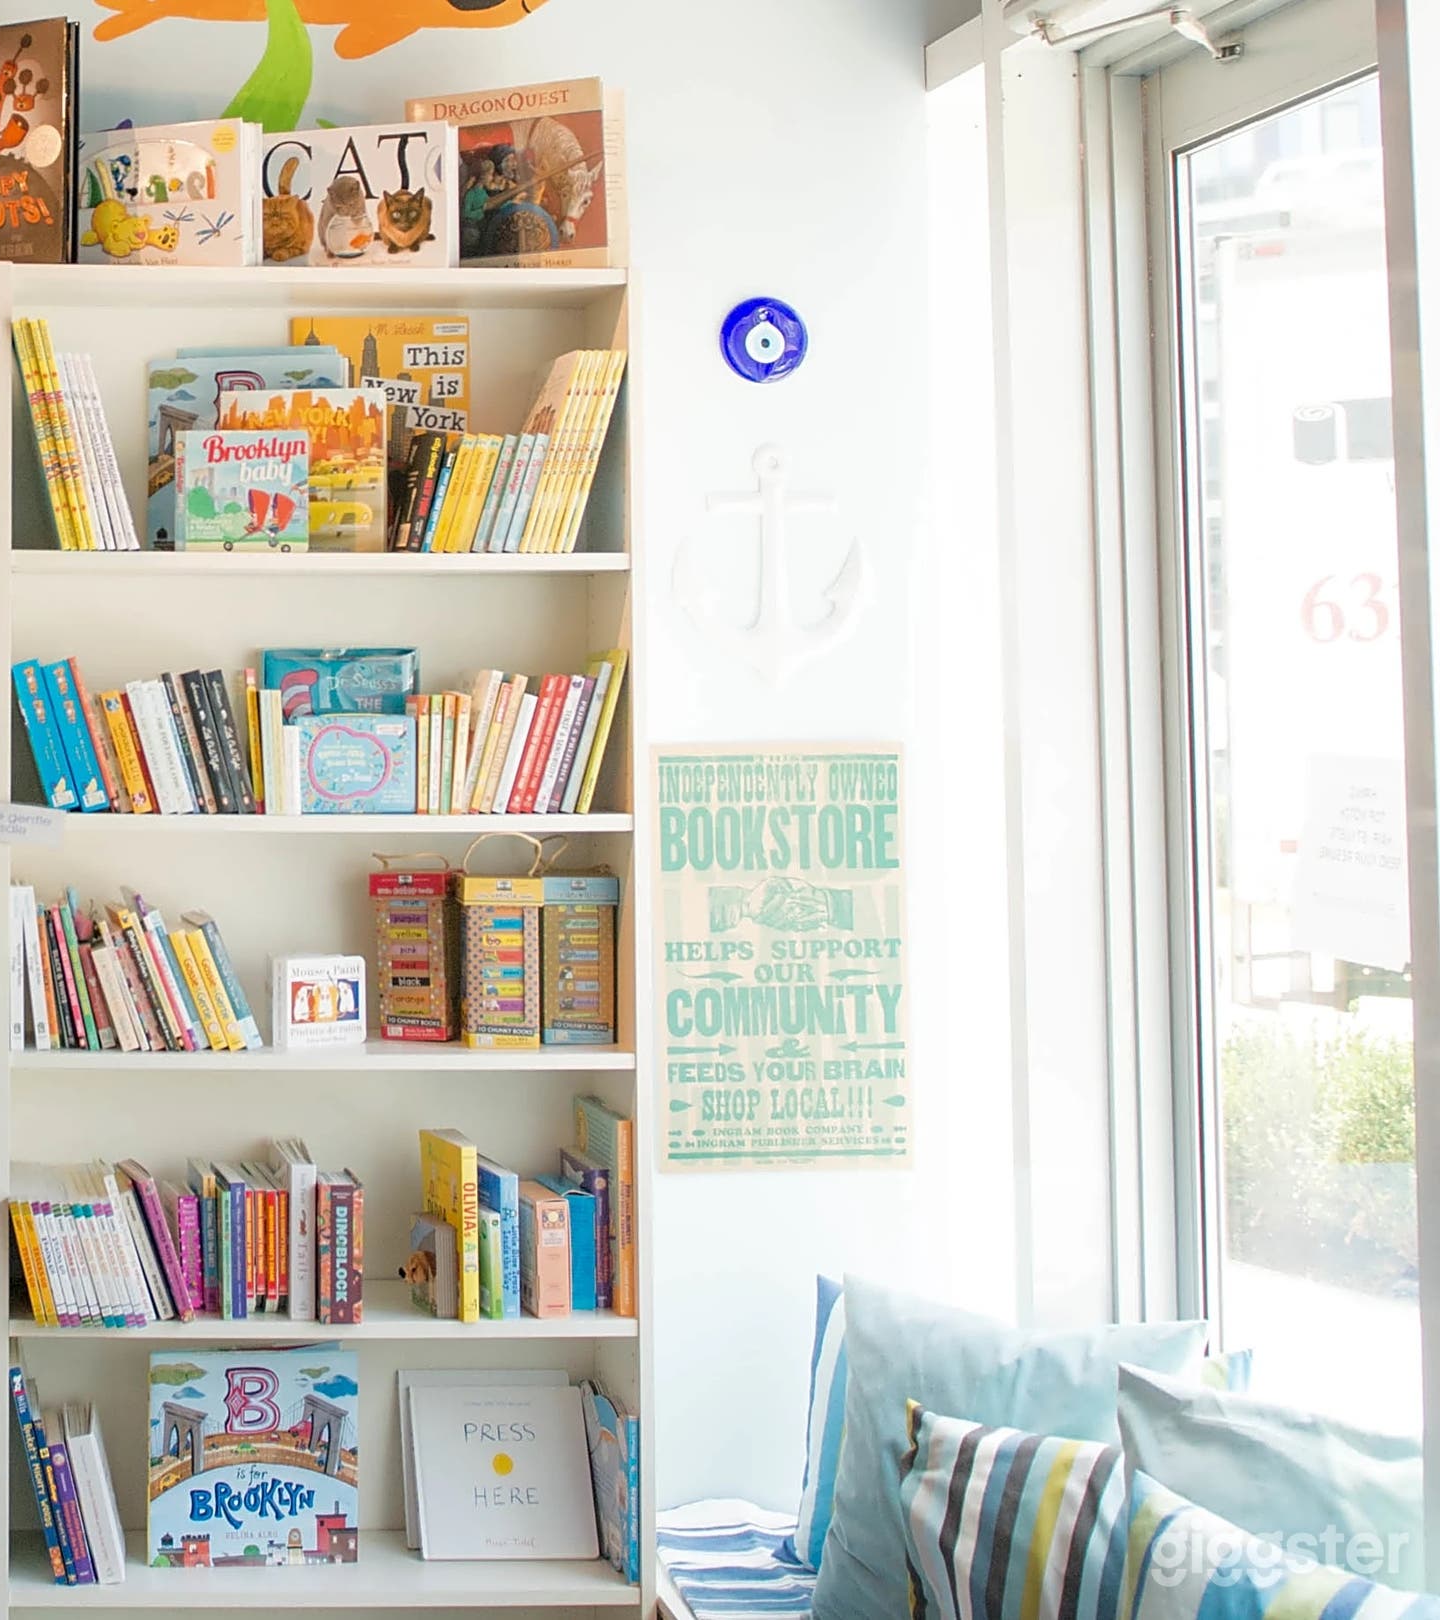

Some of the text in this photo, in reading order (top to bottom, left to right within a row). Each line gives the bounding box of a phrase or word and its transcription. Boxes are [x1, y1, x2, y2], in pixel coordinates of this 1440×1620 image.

[262, 131, 428, 204] CAT
[407, 346, 465, 367] This
[436, 376, 459, 396] is
[249, 411, 291, 429] NEW
[412, 406, 465, 432] York
[203, 434, 308, 464] Brooklyn
[239, 460, 294, 486] baby
[355, 698, 383, 711] THE
[658, 762, 898, 804] INDEPENDENTLY OWNED
[0, 823, 28, 836] sale
[7, 813, 53, 827] gentle
[660, 803, 900, 872] BOOKSTORE
[393, 914, 422, 924] purple
[396, 930, 423, 939] yellow
[399, 946, 417, 955] pink
[664, 937, 902, 963] HELPS SUPPORT
[289, 964, 362, 978] Mouse Paint
[754, 962, 815, 983] OUR
[398, 977, 422, 987] black
[388, 1016, 441, 1028] 10 CHUNKY BOOKS
[478, 1025, 534, 1036] 10 CHUNKY BOOKS
[561, 1022, 608, 1031] CHUNKY BOOKS
[667, 1058, 906, 1083] FEEDS YOUR BRAIN
[701, 1086, 874, 1122] SHOP LOCAL!!!
[712, 1124, 864, 1137] INGRAM BOOK COMPANY
[697, 1136, 879, 1149] INGRAM PUBLISHER SERVICES
[463, 1182, 477, 1237] OLIVIA's
[335, 1205, 348, 1302] DINOBLOCK
[225, 1367, 281, 1435] B
[464, 1422, 536, 1444] PRESS
[24, 1422, 52, 1527] Rocket's MIGHTY WORDS
[236, 1463, 268, 1483] is for
[189, 1478, 315, 1530] BROOKLYN
[473, 1486, 540, 1508] HERE
